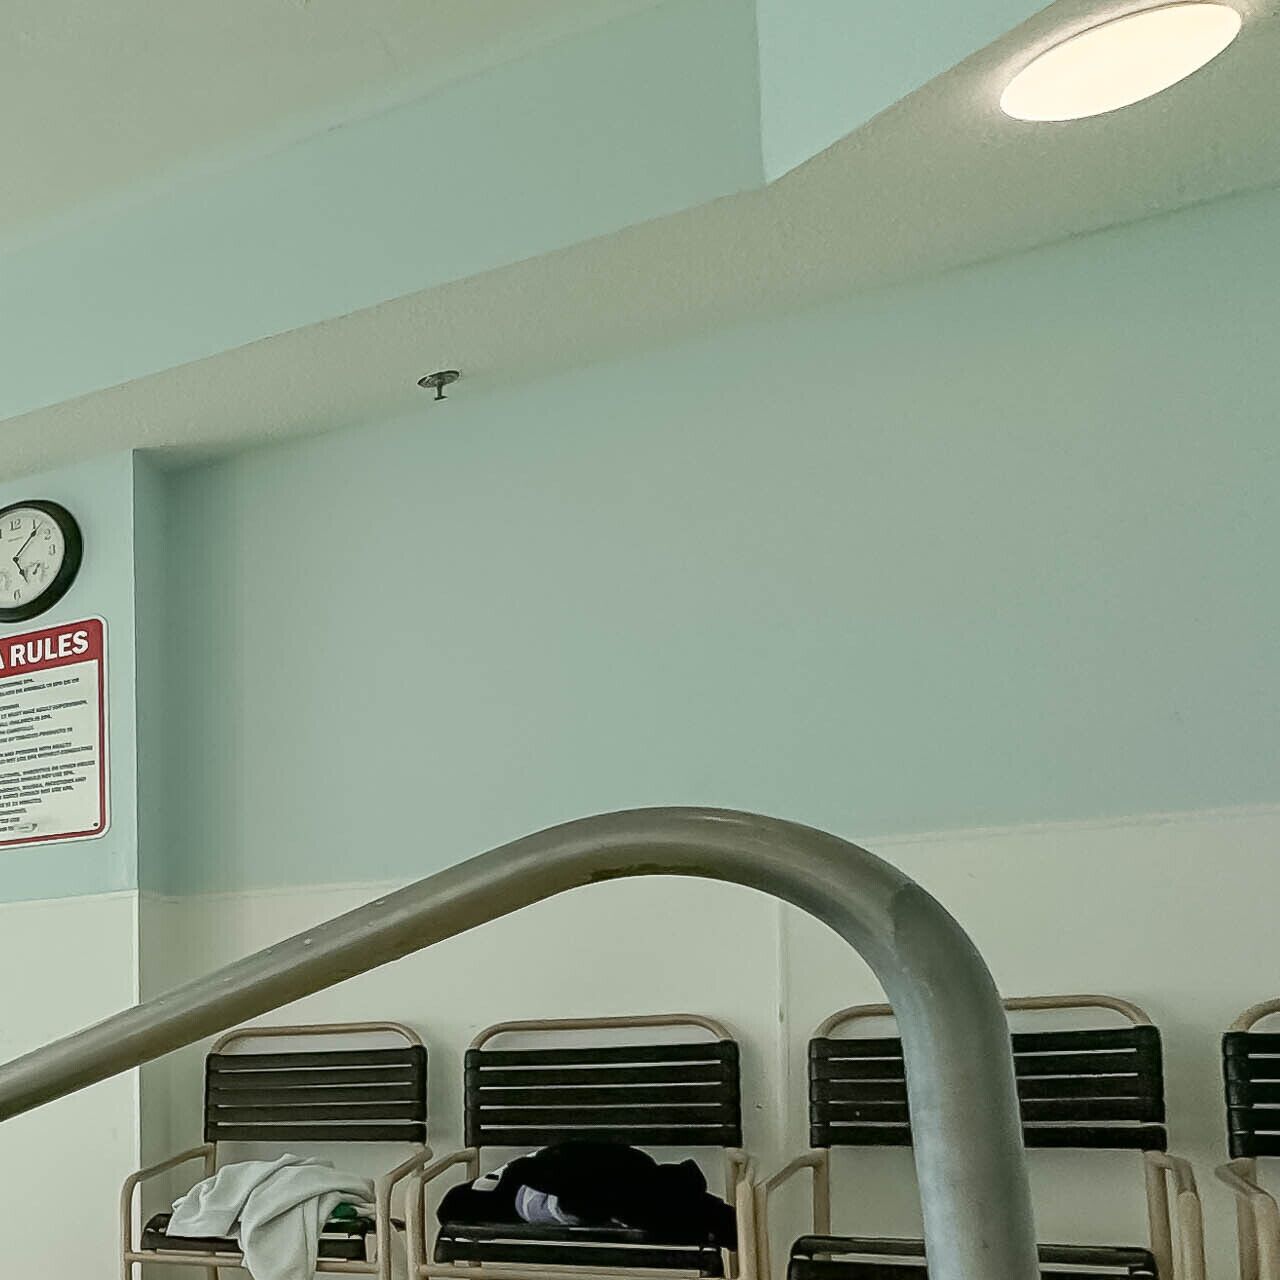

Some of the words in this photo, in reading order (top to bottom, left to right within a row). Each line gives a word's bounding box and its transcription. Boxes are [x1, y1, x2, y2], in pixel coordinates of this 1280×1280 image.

[10, 519, 21, 531] 12
[44, 529, 51, 541] 2
[48, 544, 56, 556] 3
[13, 589, 21, 601] 6
[10, 630, 89, 667] RULES
